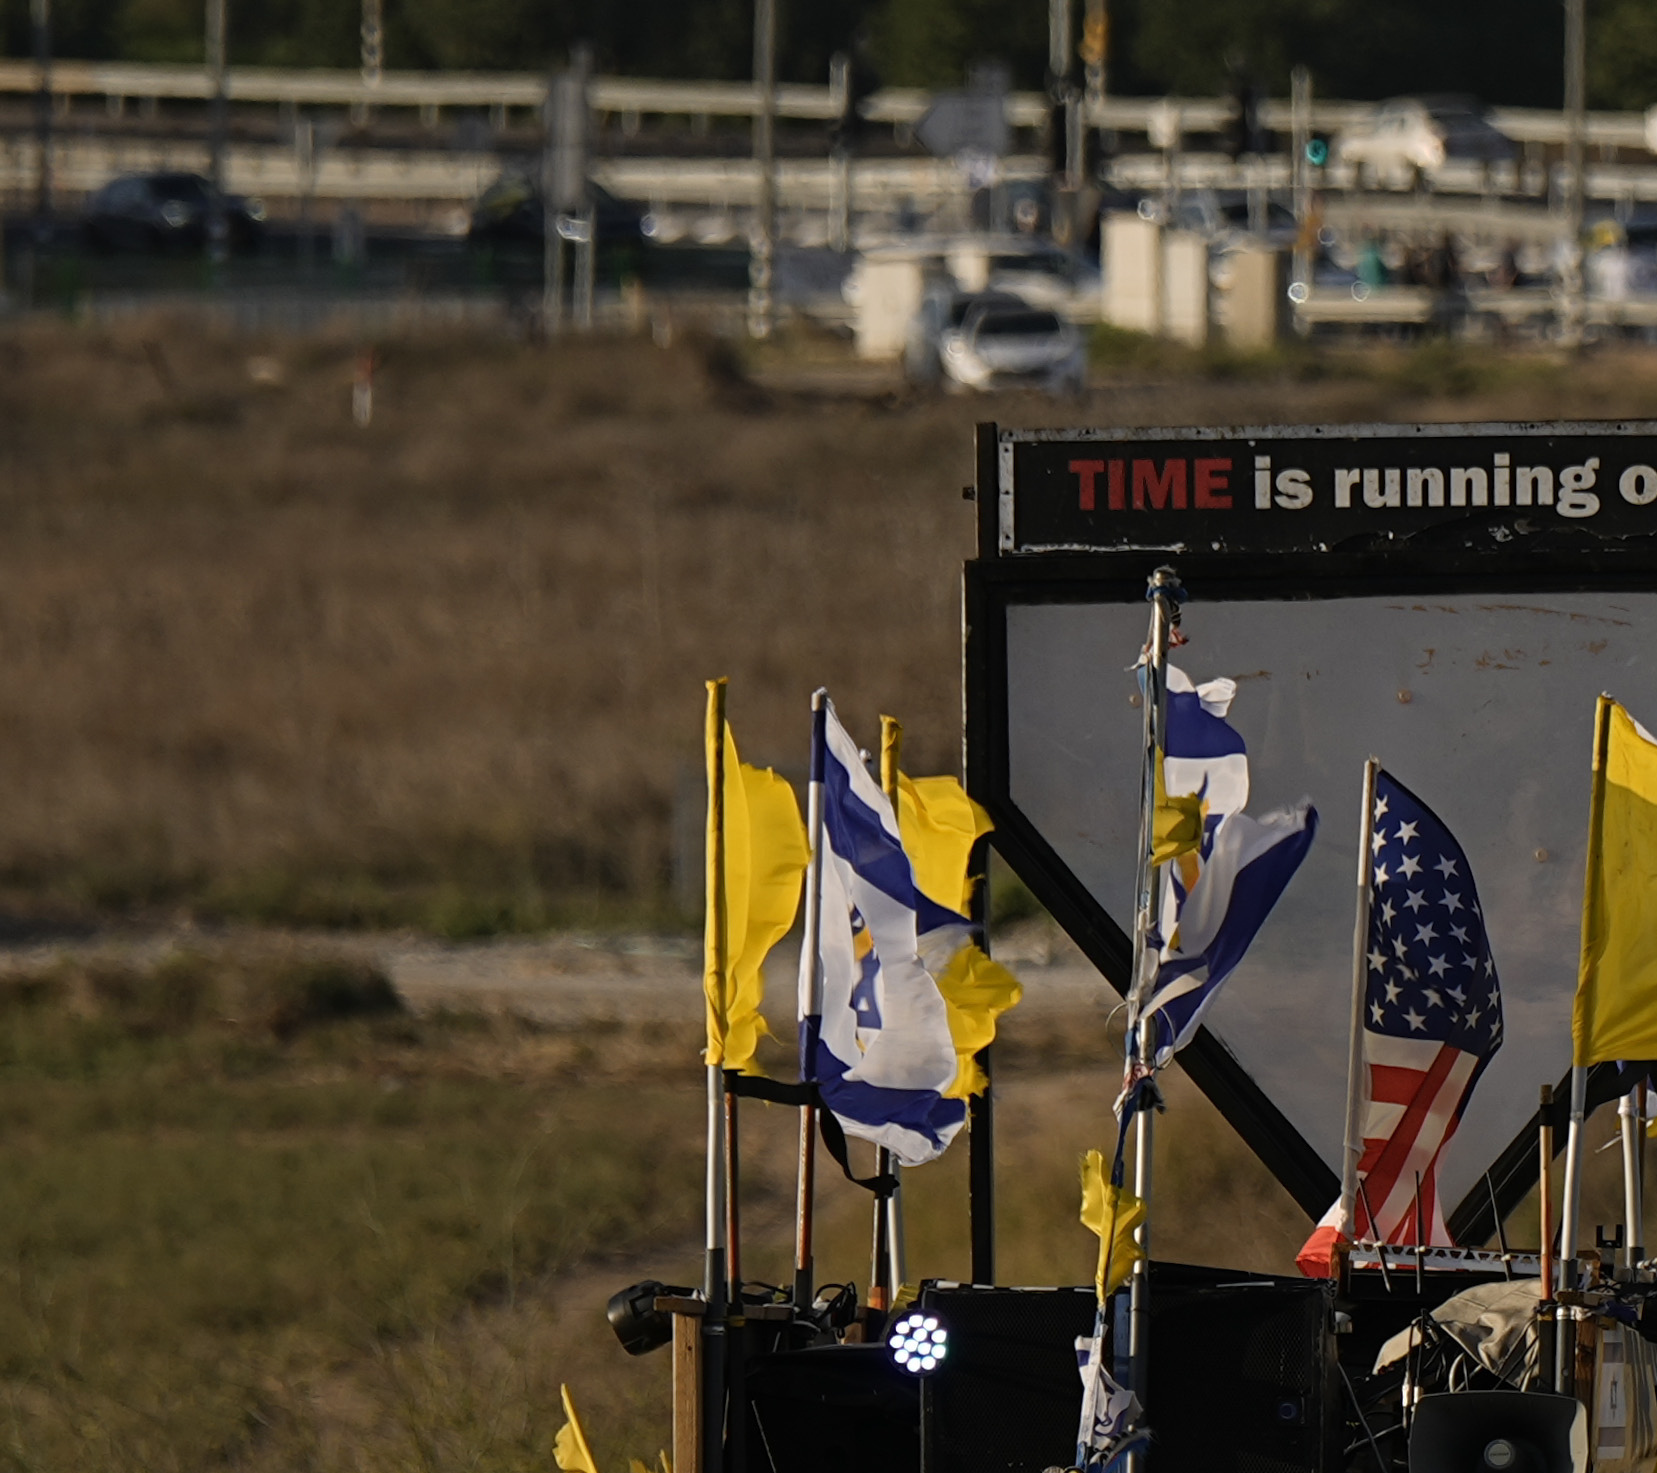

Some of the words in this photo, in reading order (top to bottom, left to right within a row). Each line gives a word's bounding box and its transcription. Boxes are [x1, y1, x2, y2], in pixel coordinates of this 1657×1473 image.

[1068, 456, 1233, 510] TIME
[1254, 454, 1313, 510] is
[1333, 452, 1600, 518] running
